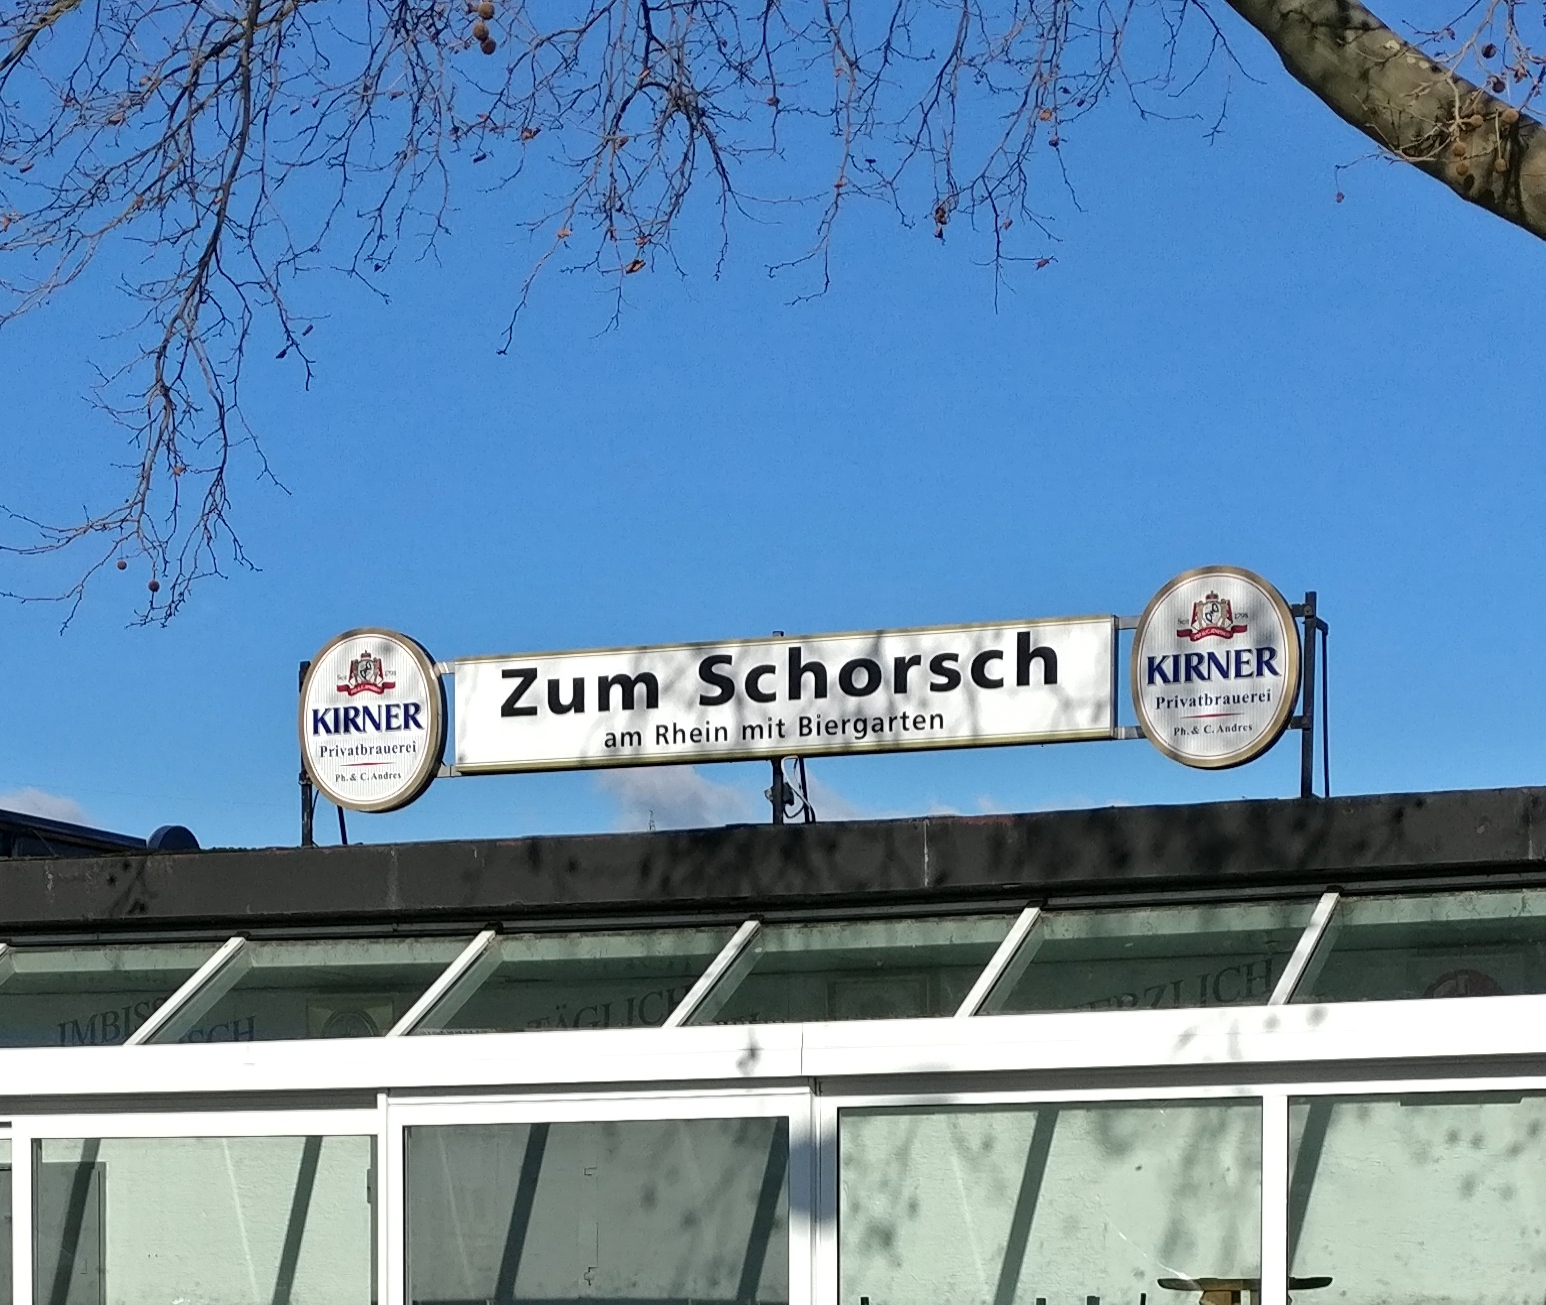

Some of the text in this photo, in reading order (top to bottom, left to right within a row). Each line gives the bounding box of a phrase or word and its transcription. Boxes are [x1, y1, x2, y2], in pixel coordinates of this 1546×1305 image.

[500, 631, 1059, 717] Zum Schorsch
[1147, 647, 1282, 686] KIRNER
[1156, 689, 1272, 709] Privatbrauerei
[311, 702, 425, 737] KIRNER
[603, 709, 945, 749] am Rhein mit Biergarten
[1217, 723, 1253, 733] Andres
[320, 740, 417, 758] Privatbrauerei
[372, 772, 402, 780] Andres
